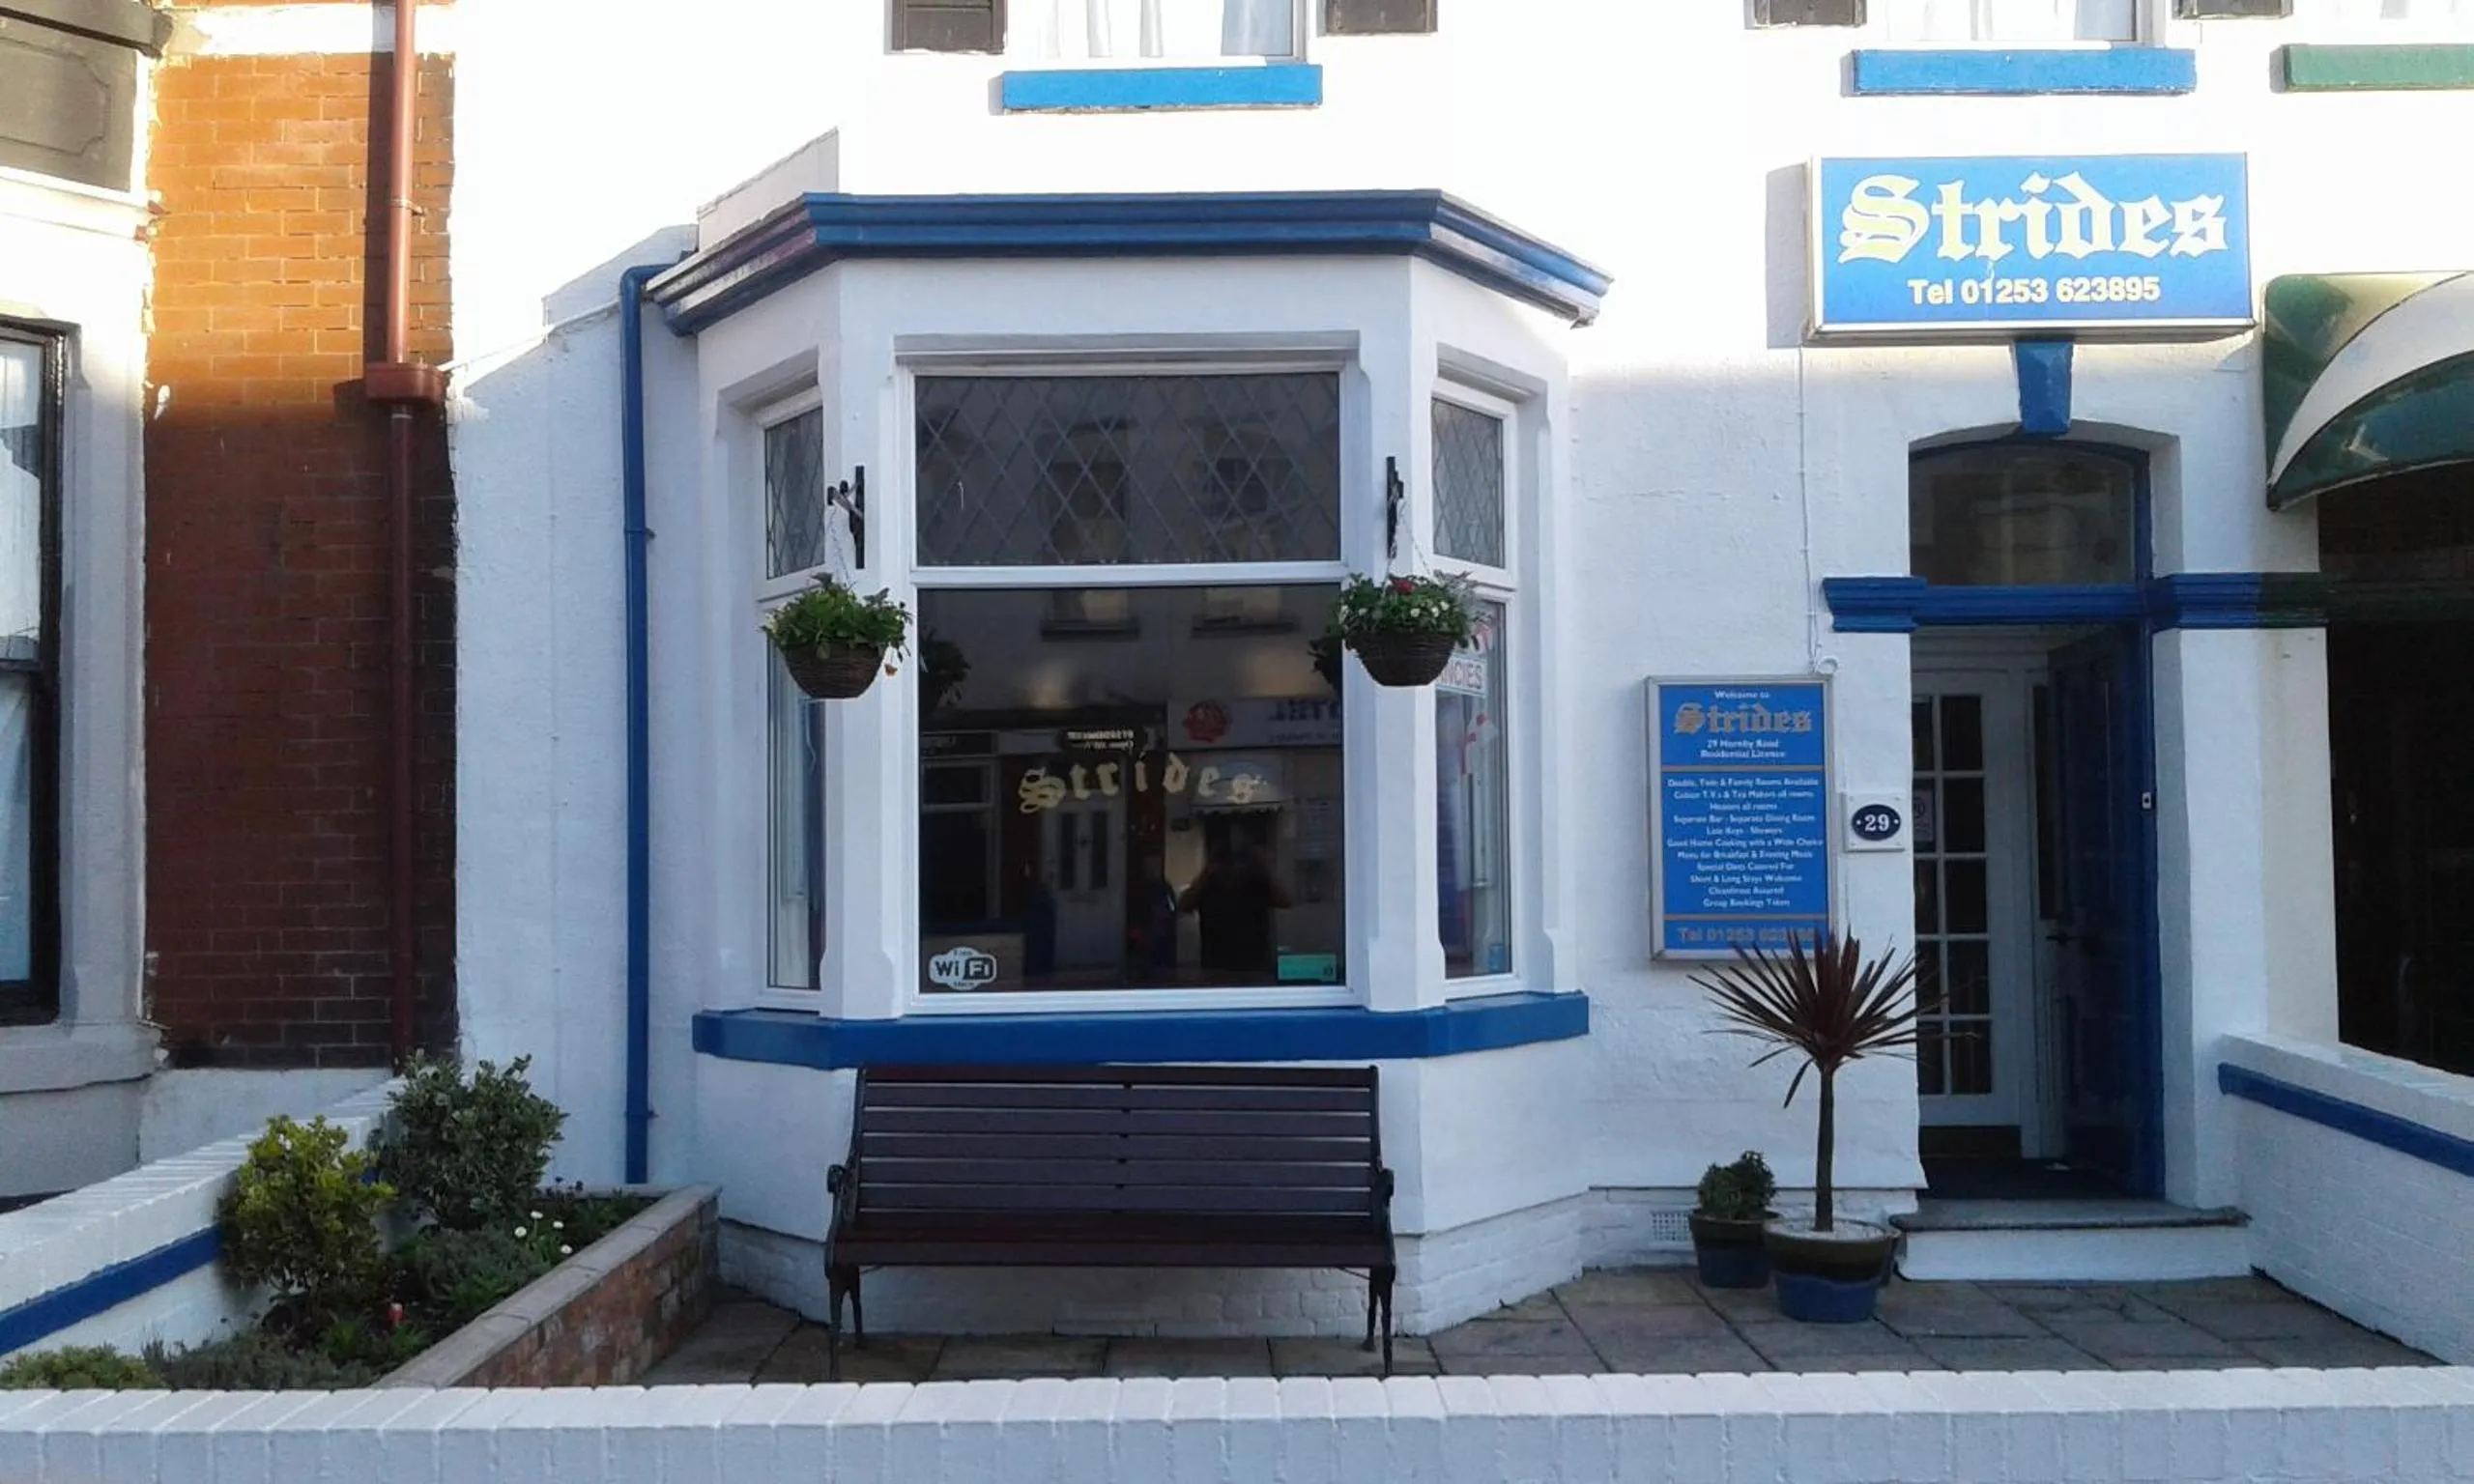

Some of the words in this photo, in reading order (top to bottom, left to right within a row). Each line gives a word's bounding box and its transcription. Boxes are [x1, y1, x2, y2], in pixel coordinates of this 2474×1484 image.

[1838, 170, 2229, 264] Strides
[1908, 279, 1953, 304] Tel
[1961, 278, 2050, 304] 01253
[2056, 276, 2161, 302] 623895
[1714, 690, 1758, 699] Welcome
[1760, 691, 1770, 699] to
[1674, 701, 1813, 734] Strides
[1707, 739, 1718, 749] 29
[1719, 738, 1754, 750] Hornby
[1756, 739, 1779, 749] Road
[1700, 749, 1750, 758] Residential
[1751, 749, 1786, 758] Licence
[1018, 751, 1268, 814] Strides
[1728, 778, 1753, 788] Family
[1755, 778, 1782, 786] Rooms
[1783, 778, 1819, 786] Available
[1747, 789, 1776, 799] Makers
[1673, 814, 1707, 825] Separate
[1709, 814, 1723, 824] Bar
[1729, 813, 1764, 825] Separate
[1765, 813, 1791, 824] Dining
[1792, 813, 1815, 823] Room
[1864, 813, 1889, 832] 29
[1750, 826, 1783, 835] Showers
[1689, 838, 1713, 847] Home
[1714, 839, 1747, 848] Cooking
[1713, 850, 1749, 860] Breakfast
[1759, 850, 1789, 861] Evening
[1697, 862, 1724, 871] Special
[1725, 862, 1745, 871] Diets
[1780, 862, 1795, 870] For
[1689, 875, 1712, 884] Short
[1721, 874, 1741, 885] Long
[1742, 874, 1763, 884] Stays
[1764, 874, 1802, 883] Welcome
[1708, 886, 1752, 896] Cleanliness
[1753, 886, 1784, 896] Assured
[1703, 898, 1729, 908] Group
[1730, 898, 1764, 908] Bookings
[1766, 899, 1791, 907] Taken
[1677, 927, 1703, 942] Tel
[1706, 927, 1755, 942] 01253
[935, 959, 992, 977] WiFi
